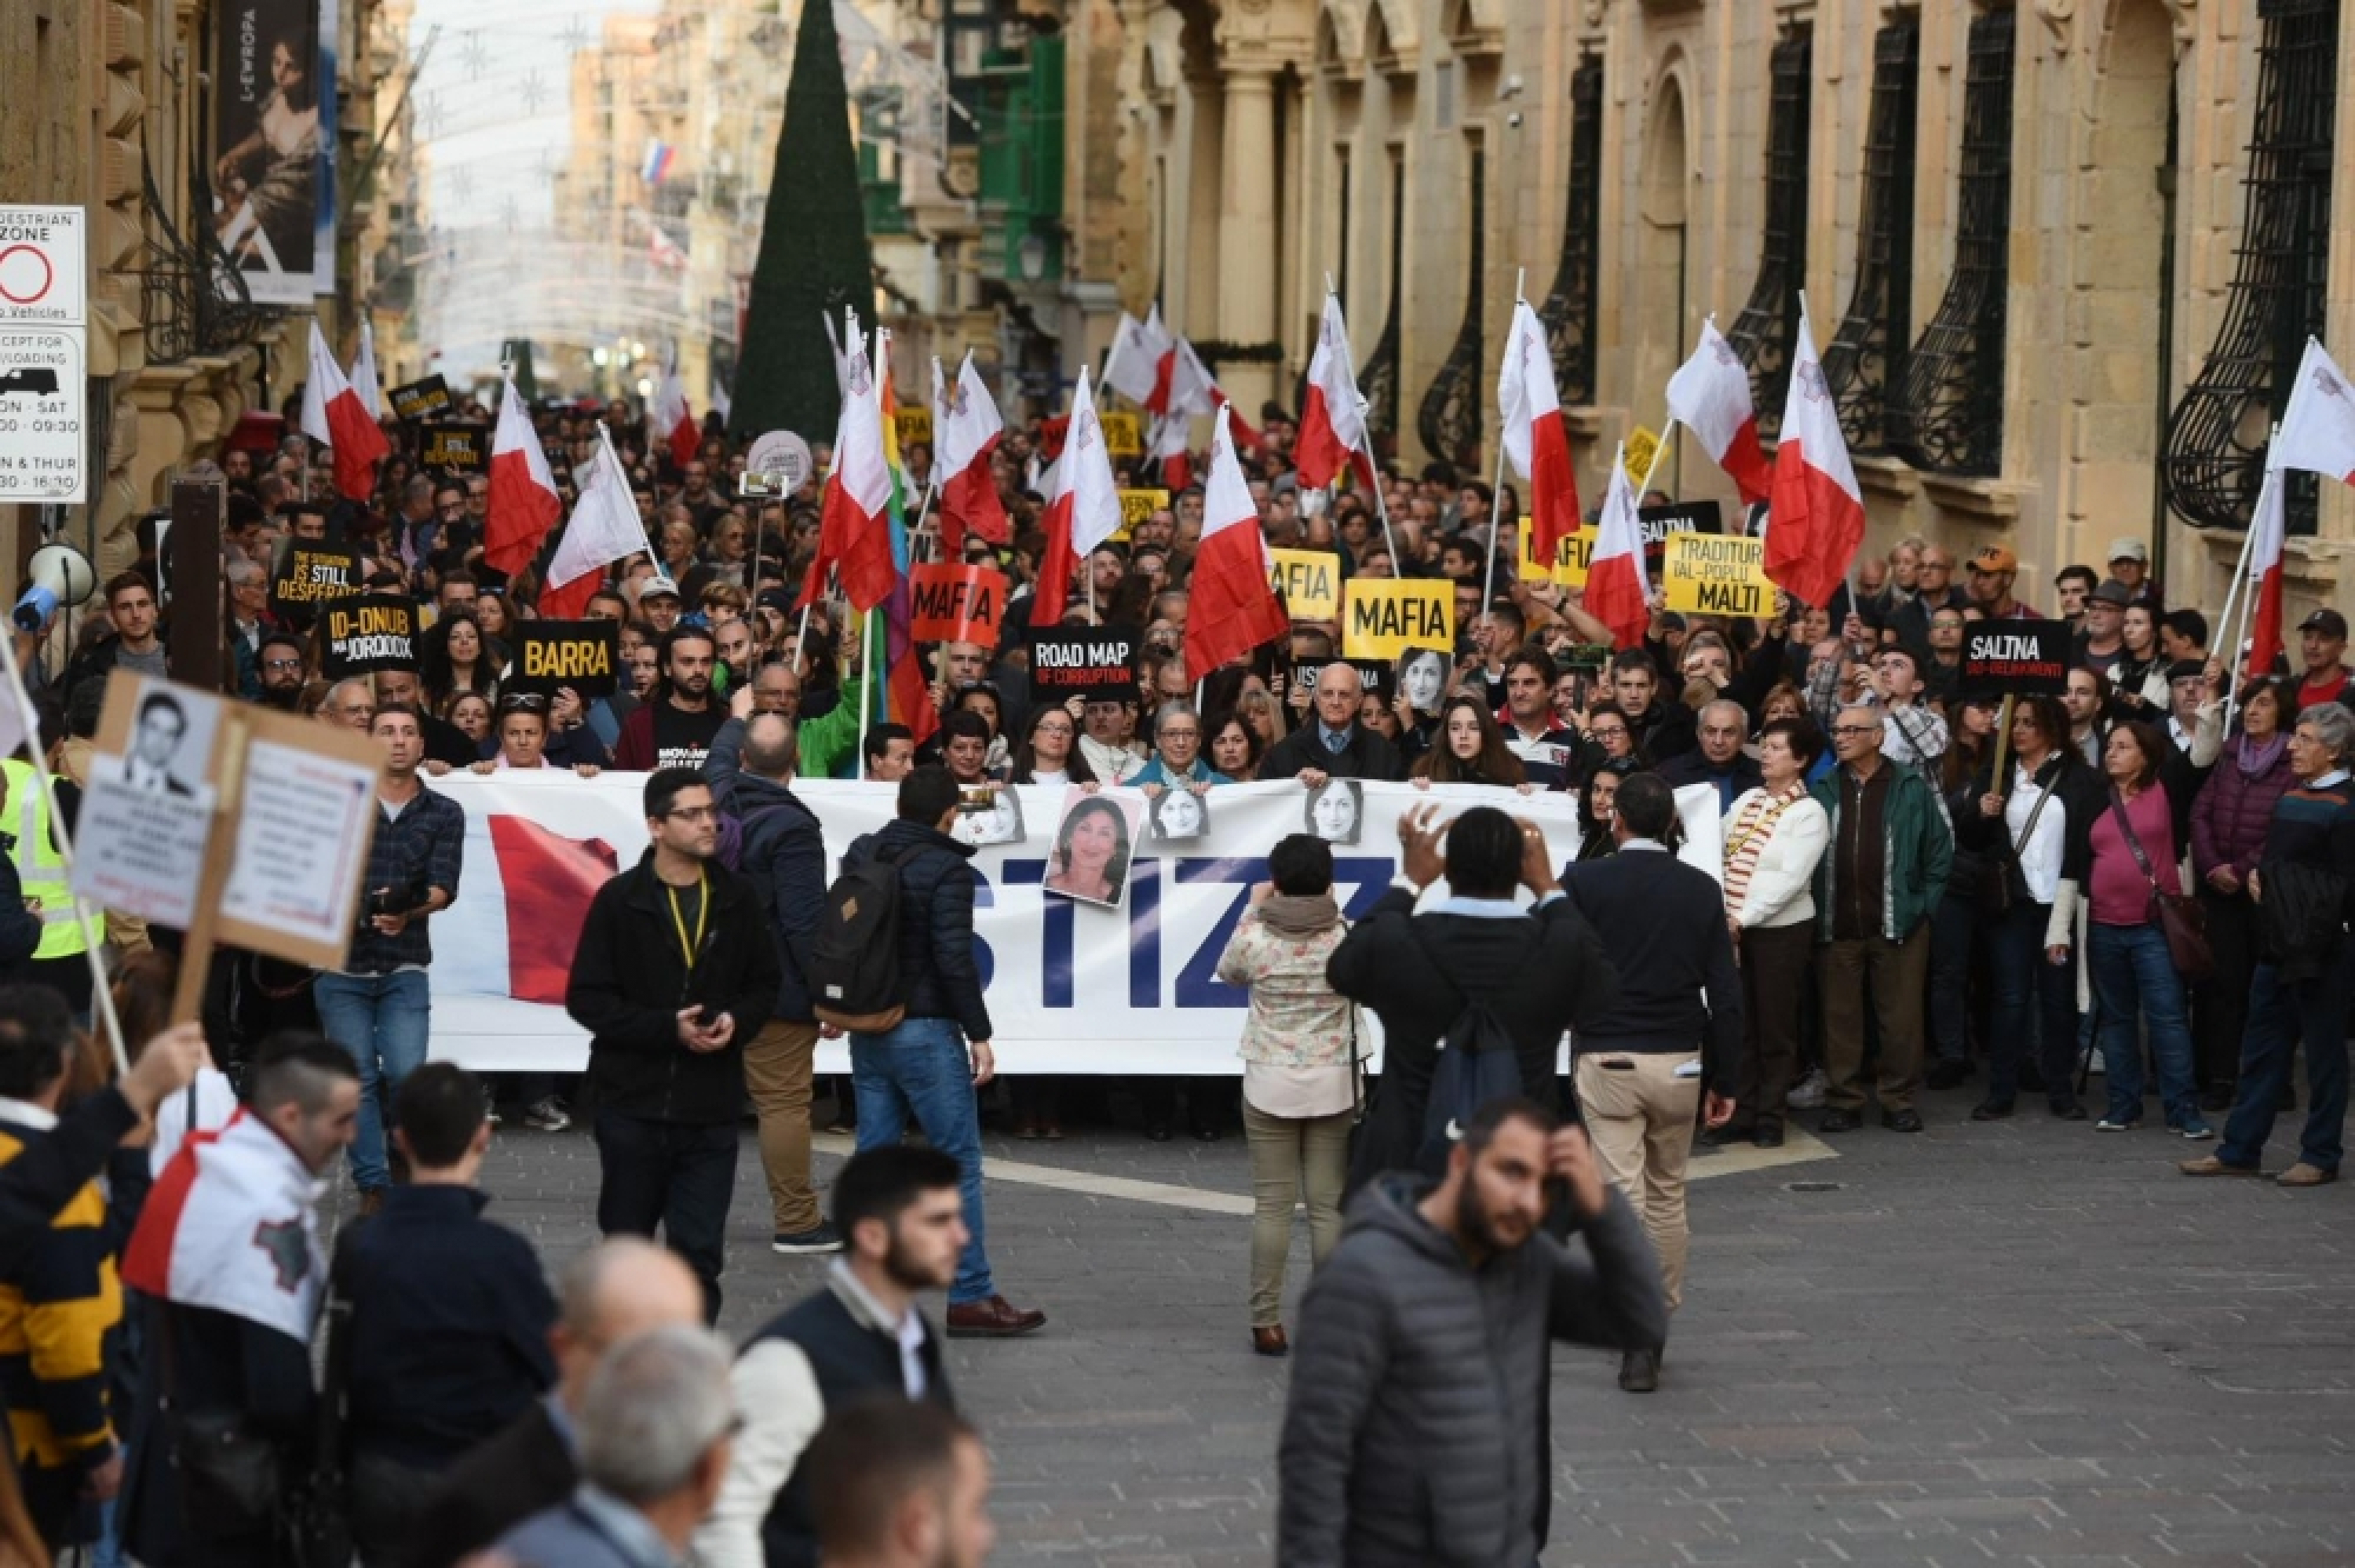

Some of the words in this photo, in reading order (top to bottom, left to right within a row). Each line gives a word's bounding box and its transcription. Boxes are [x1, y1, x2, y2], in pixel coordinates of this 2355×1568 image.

[9, 305, 66, 318] Vehicles
[37, 336, 63, 348] FOR
[37, 400, 67, 414] SAT
[32, 419, 78, 433] 09:30
[32, 457, 76, 470] THUR
[1678, 537, 1762, 565] TRADITUR
[311, 563, 348, 585] STILL
[1271, 560, 1331, 601] AFIA
[912, 581, 991, 627] MAFIA
[1696, 580, 1761, 613] MALTI
[1353, 596, 1448, 639] MAFIA
[524, 640, 611, 676] BARRA
[1035, 642, 1084, 667] ROAD
[1087, 640, 1130, 666] MAP
[1970, 635, 2041, 661] SALTNA
[1035, 668, 1052, 685] OF
[1054, 668, 1132, 685] CORRUPTION
